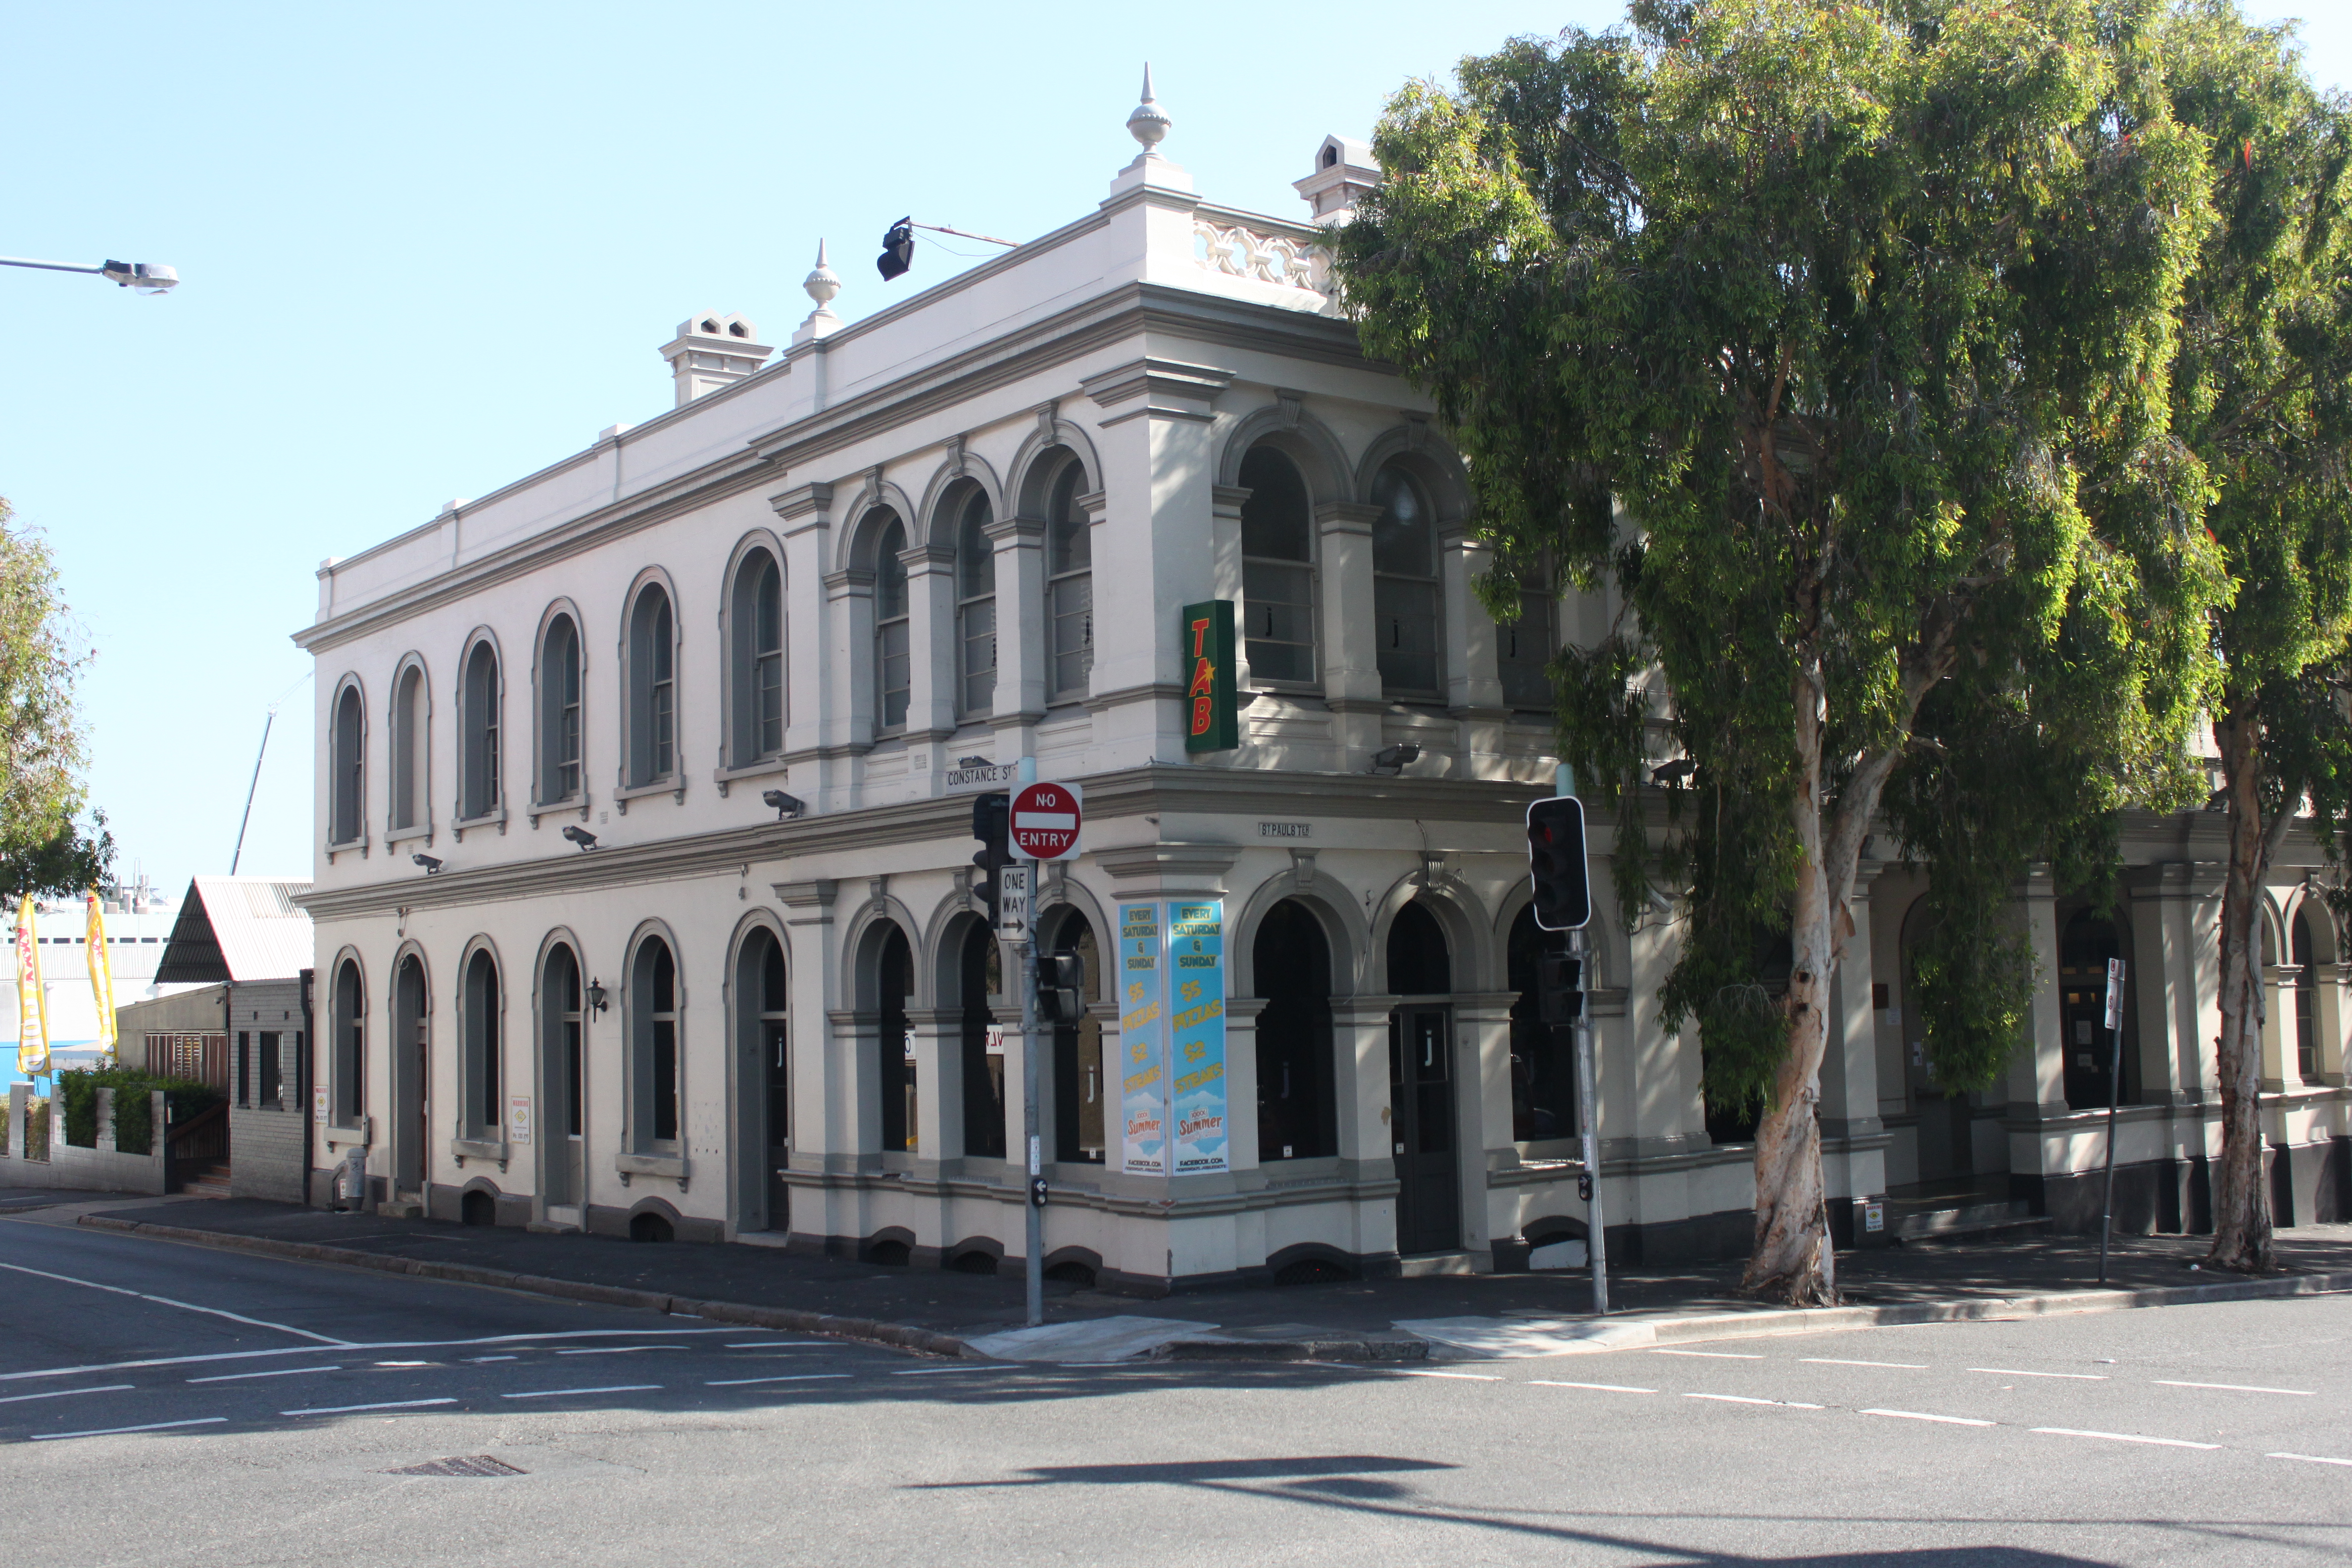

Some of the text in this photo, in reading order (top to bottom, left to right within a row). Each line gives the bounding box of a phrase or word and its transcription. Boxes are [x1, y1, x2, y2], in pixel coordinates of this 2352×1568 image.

[1189, 618, 1212, 735] TAB
[948, 766, 1011, 785] CONSTANCE ST
[1036, 793, 1056, 807] NO
[1272, 824, 1296, 836] PAULS
[1020, 833, 1070, 847] ENTRY
[1005, 873, 1025, 890] ONE
[1002, 896, 1026, 913] WAY
[1128, 908, 1152, 922] EVERY
[1181, 907, 1212, 921] EVERY
[1123, 924, 1158, 939] SATURDAY
[1173, 923, 1221, 937] SATURDAY
[1127, 956, 1156, 970] SUNDAY
[1178, 955, 1218, 968] SUNDAY
[1128, 981, 1144, 1004] $5
[1180, 980, 1202, 1003] $5
[1122, 1001, 1160, 1034] PIZZAS
[1172, 999, 1224, 1033] PIZZAS
[1130, 1042, 1148, 1064] $2
[1183, 1041, 1206, 1064] $2
[1123, 1065, 1162, 1094] STEAKS
[1174, 1062, 1224, 1094] STEAKS
[1128, 1119, 1161, 1135] Summer
[1179, 1117, 1223, 1136] Summer
[1179, 1157, 1224, 1167] FACEBOOK.COM
